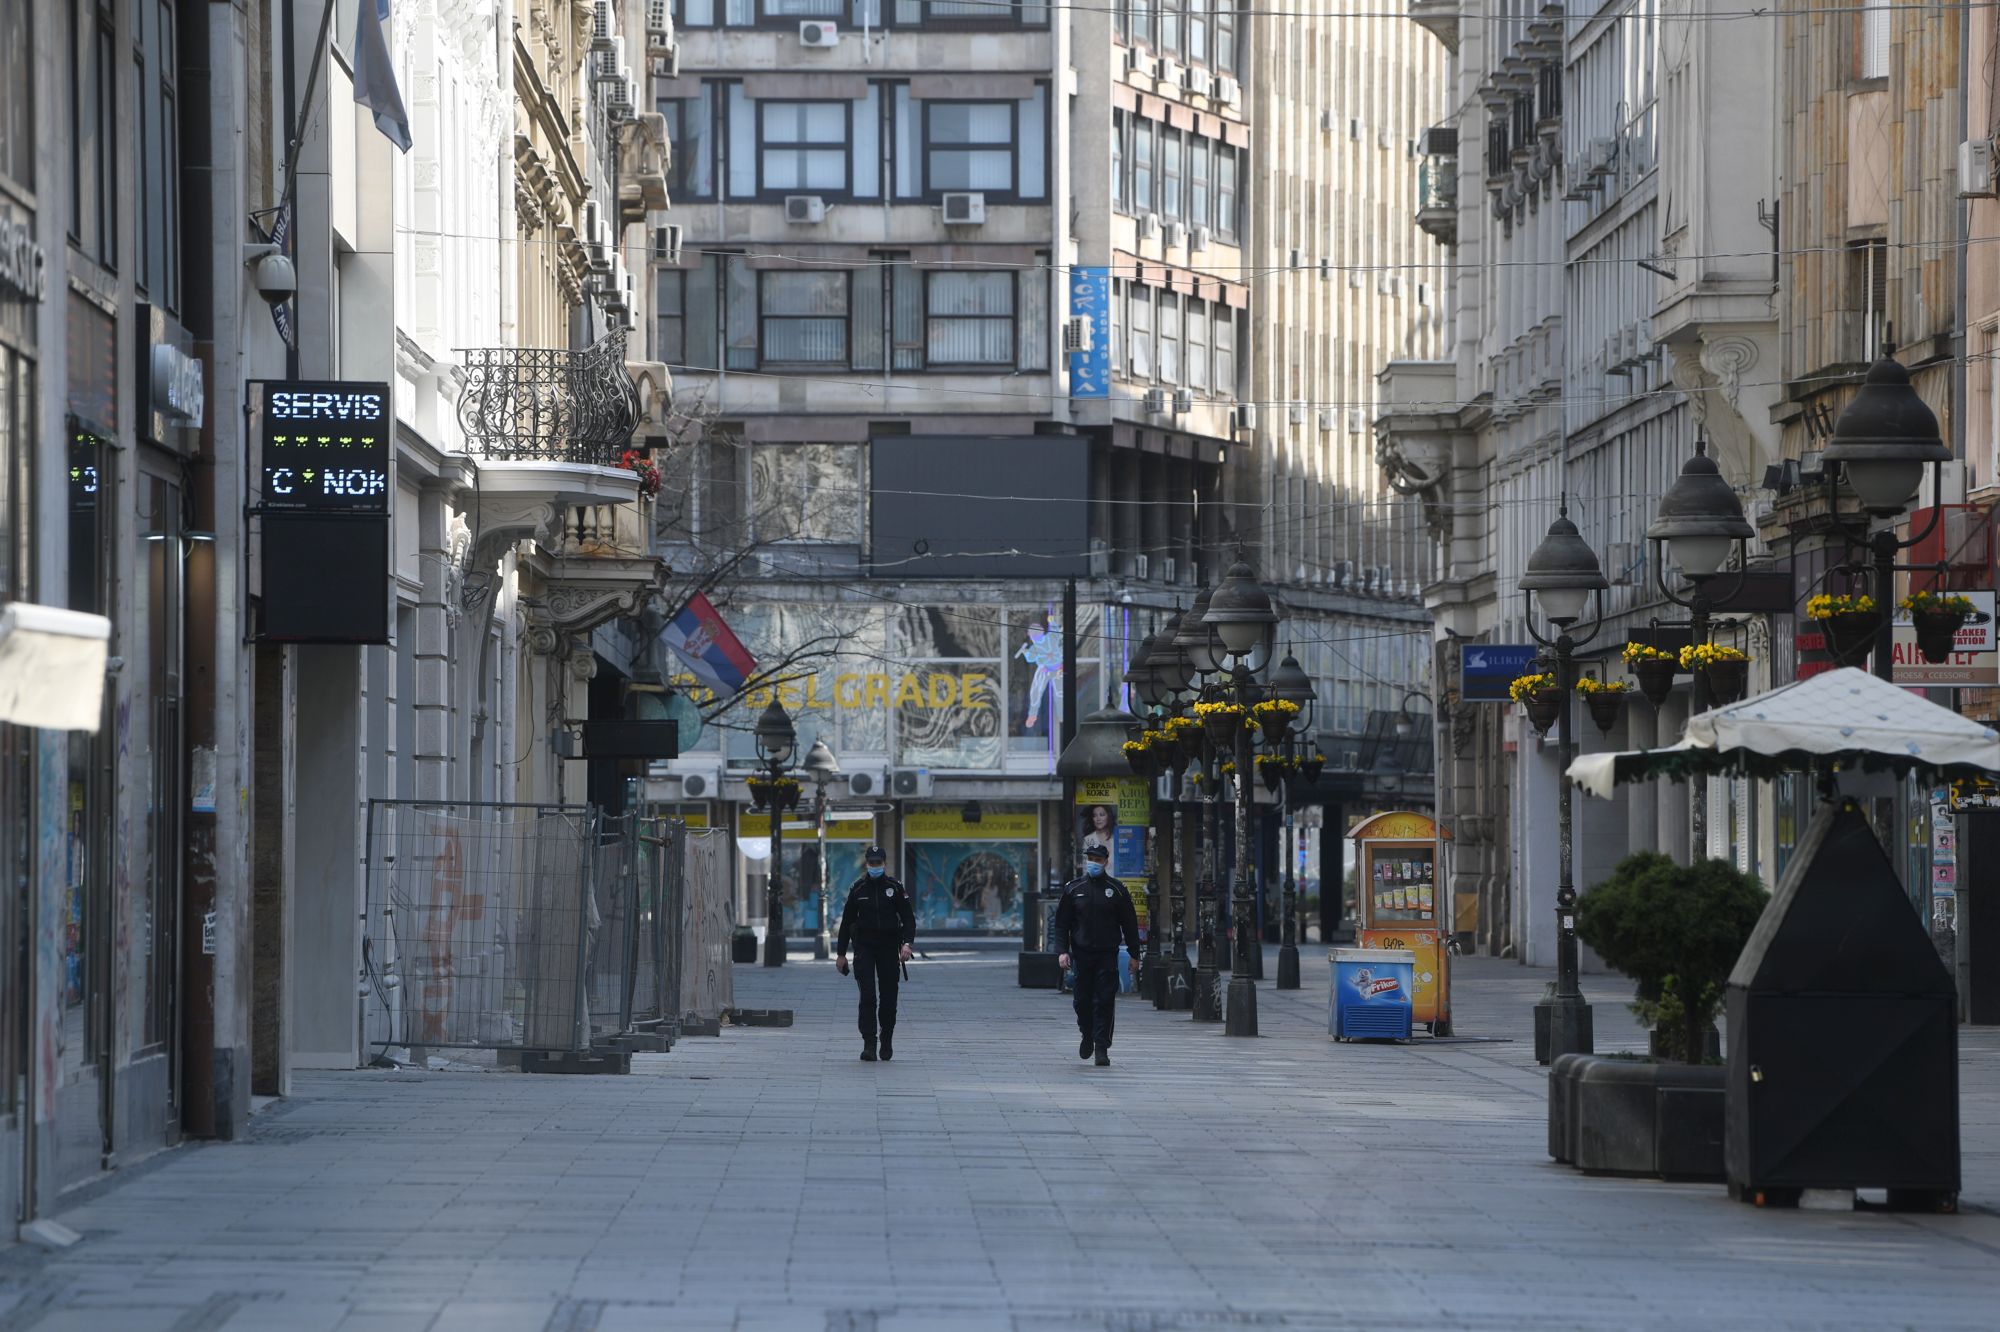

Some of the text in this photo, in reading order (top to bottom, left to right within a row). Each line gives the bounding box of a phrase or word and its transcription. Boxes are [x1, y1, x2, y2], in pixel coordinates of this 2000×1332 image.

[1074, 270, 1096, 392] IGRAICA
[272, 393, 380, 419] SERVIS
[1952, 637, 1985, 645] TATION
[1489, 655, 1528, 665] ILIRIK
[746, 673, 986, 709] BELGRADE
[911, 821, 963, 831] BELGRADE
[1371, 980, 1398, 992] Frikom
